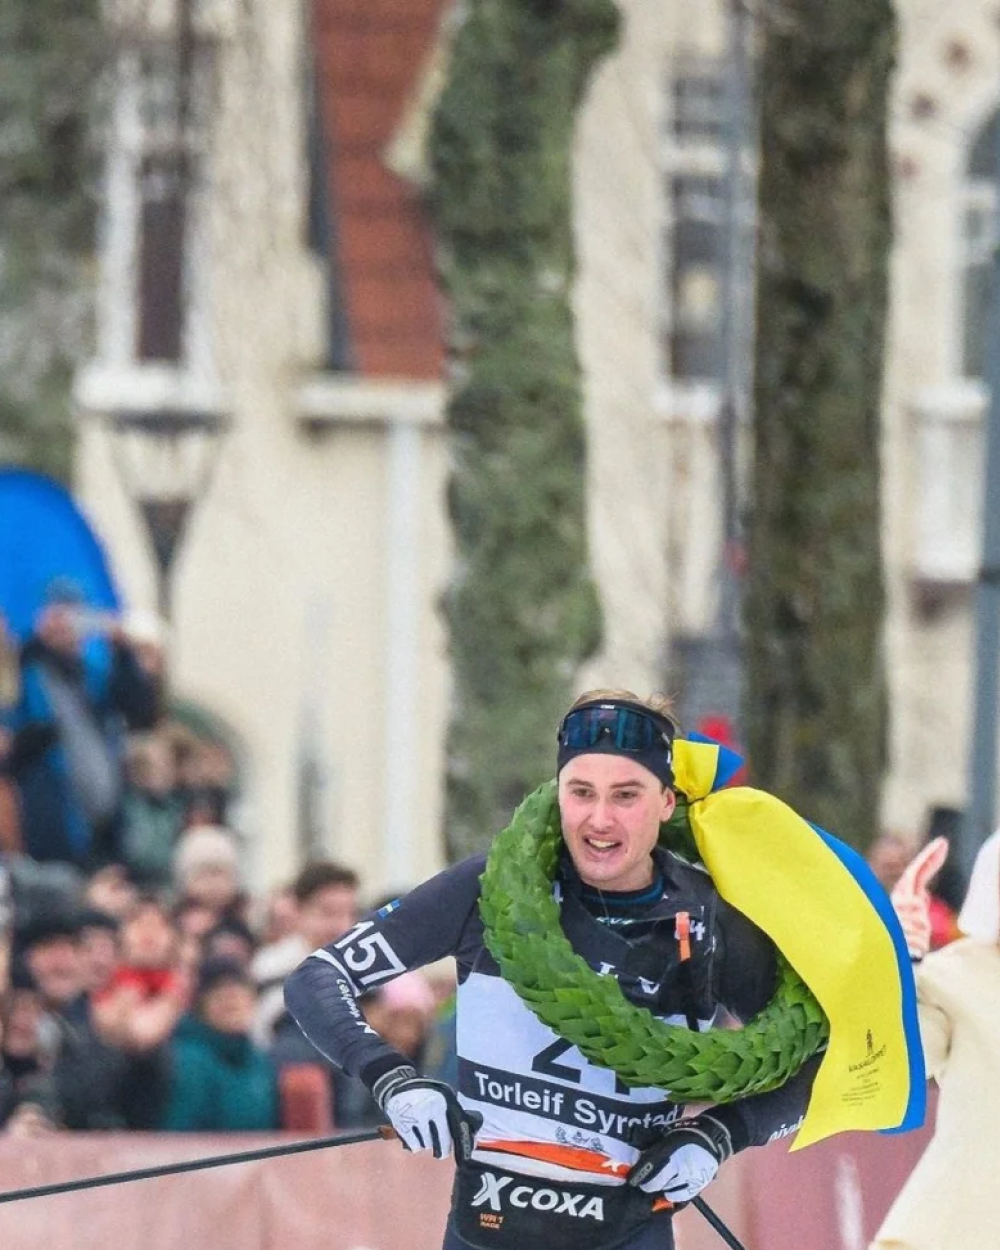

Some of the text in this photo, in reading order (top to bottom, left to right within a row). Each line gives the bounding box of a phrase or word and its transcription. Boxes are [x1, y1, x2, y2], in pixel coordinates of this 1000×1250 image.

[333, 920, 408, 986] 157
[474, 1071, 564, 1116] Torleif
[509, 1186, 604, 1221] COXA
